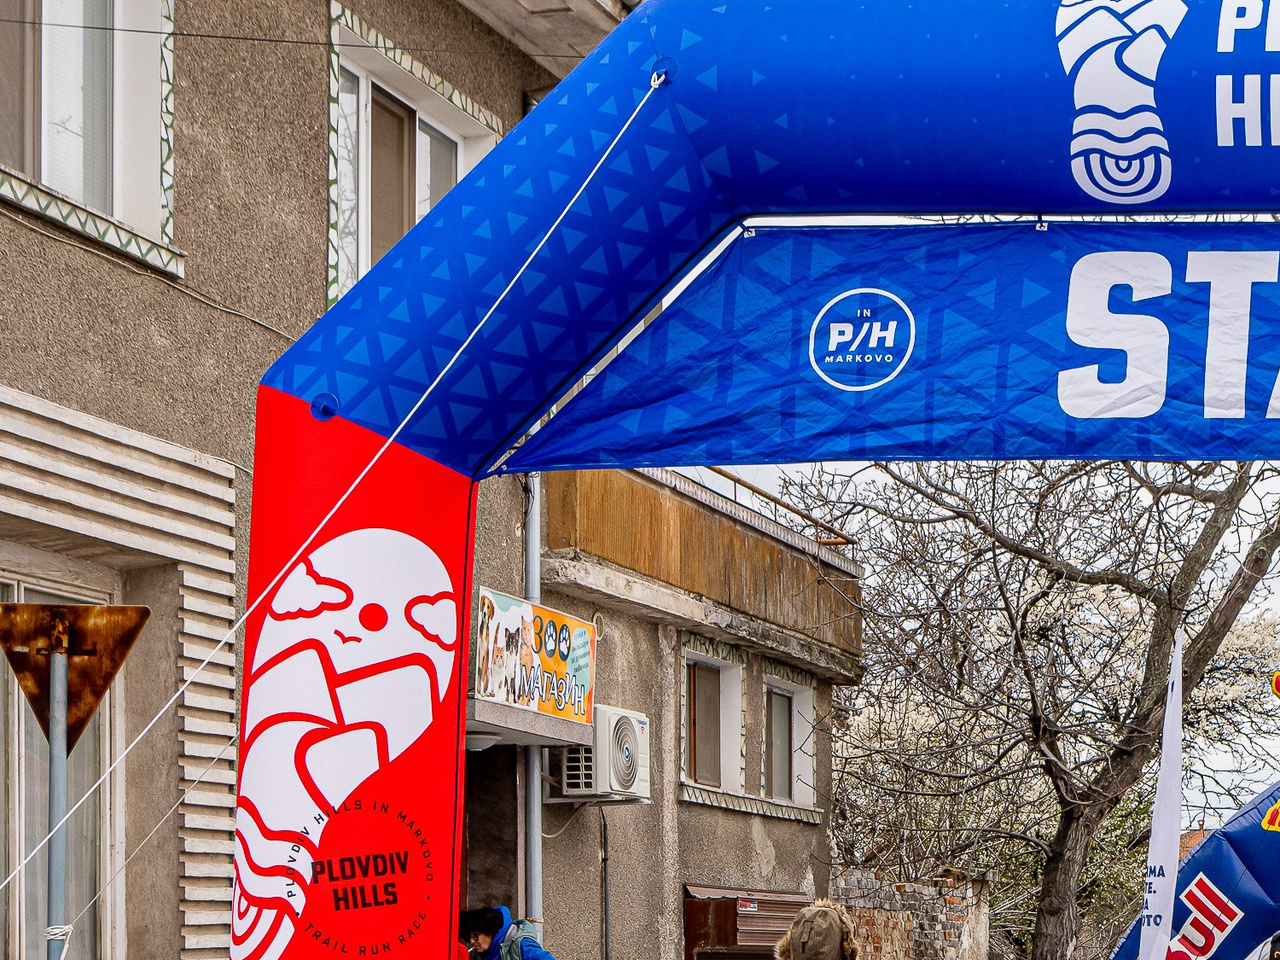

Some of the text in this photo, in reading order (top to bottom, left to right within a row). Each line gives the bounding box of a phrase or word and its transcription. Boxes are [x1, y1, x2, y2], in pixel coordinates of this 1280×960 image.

[857, 309, 870, 317] IN
[828, 321, 897, 351] P/H
[825, 354, 893, 363] MARKOVO
[520, 664, 586, 716] МАГАЗИН
[286, 800, 433, 898] PLOVDIV HILLS IN MARKOVO
[311, 851, 408, 884] PLOVDIV
[333, 883, 398, 911] HILLS
[305, 912, 425, 956] TRAIL RUN RACE
